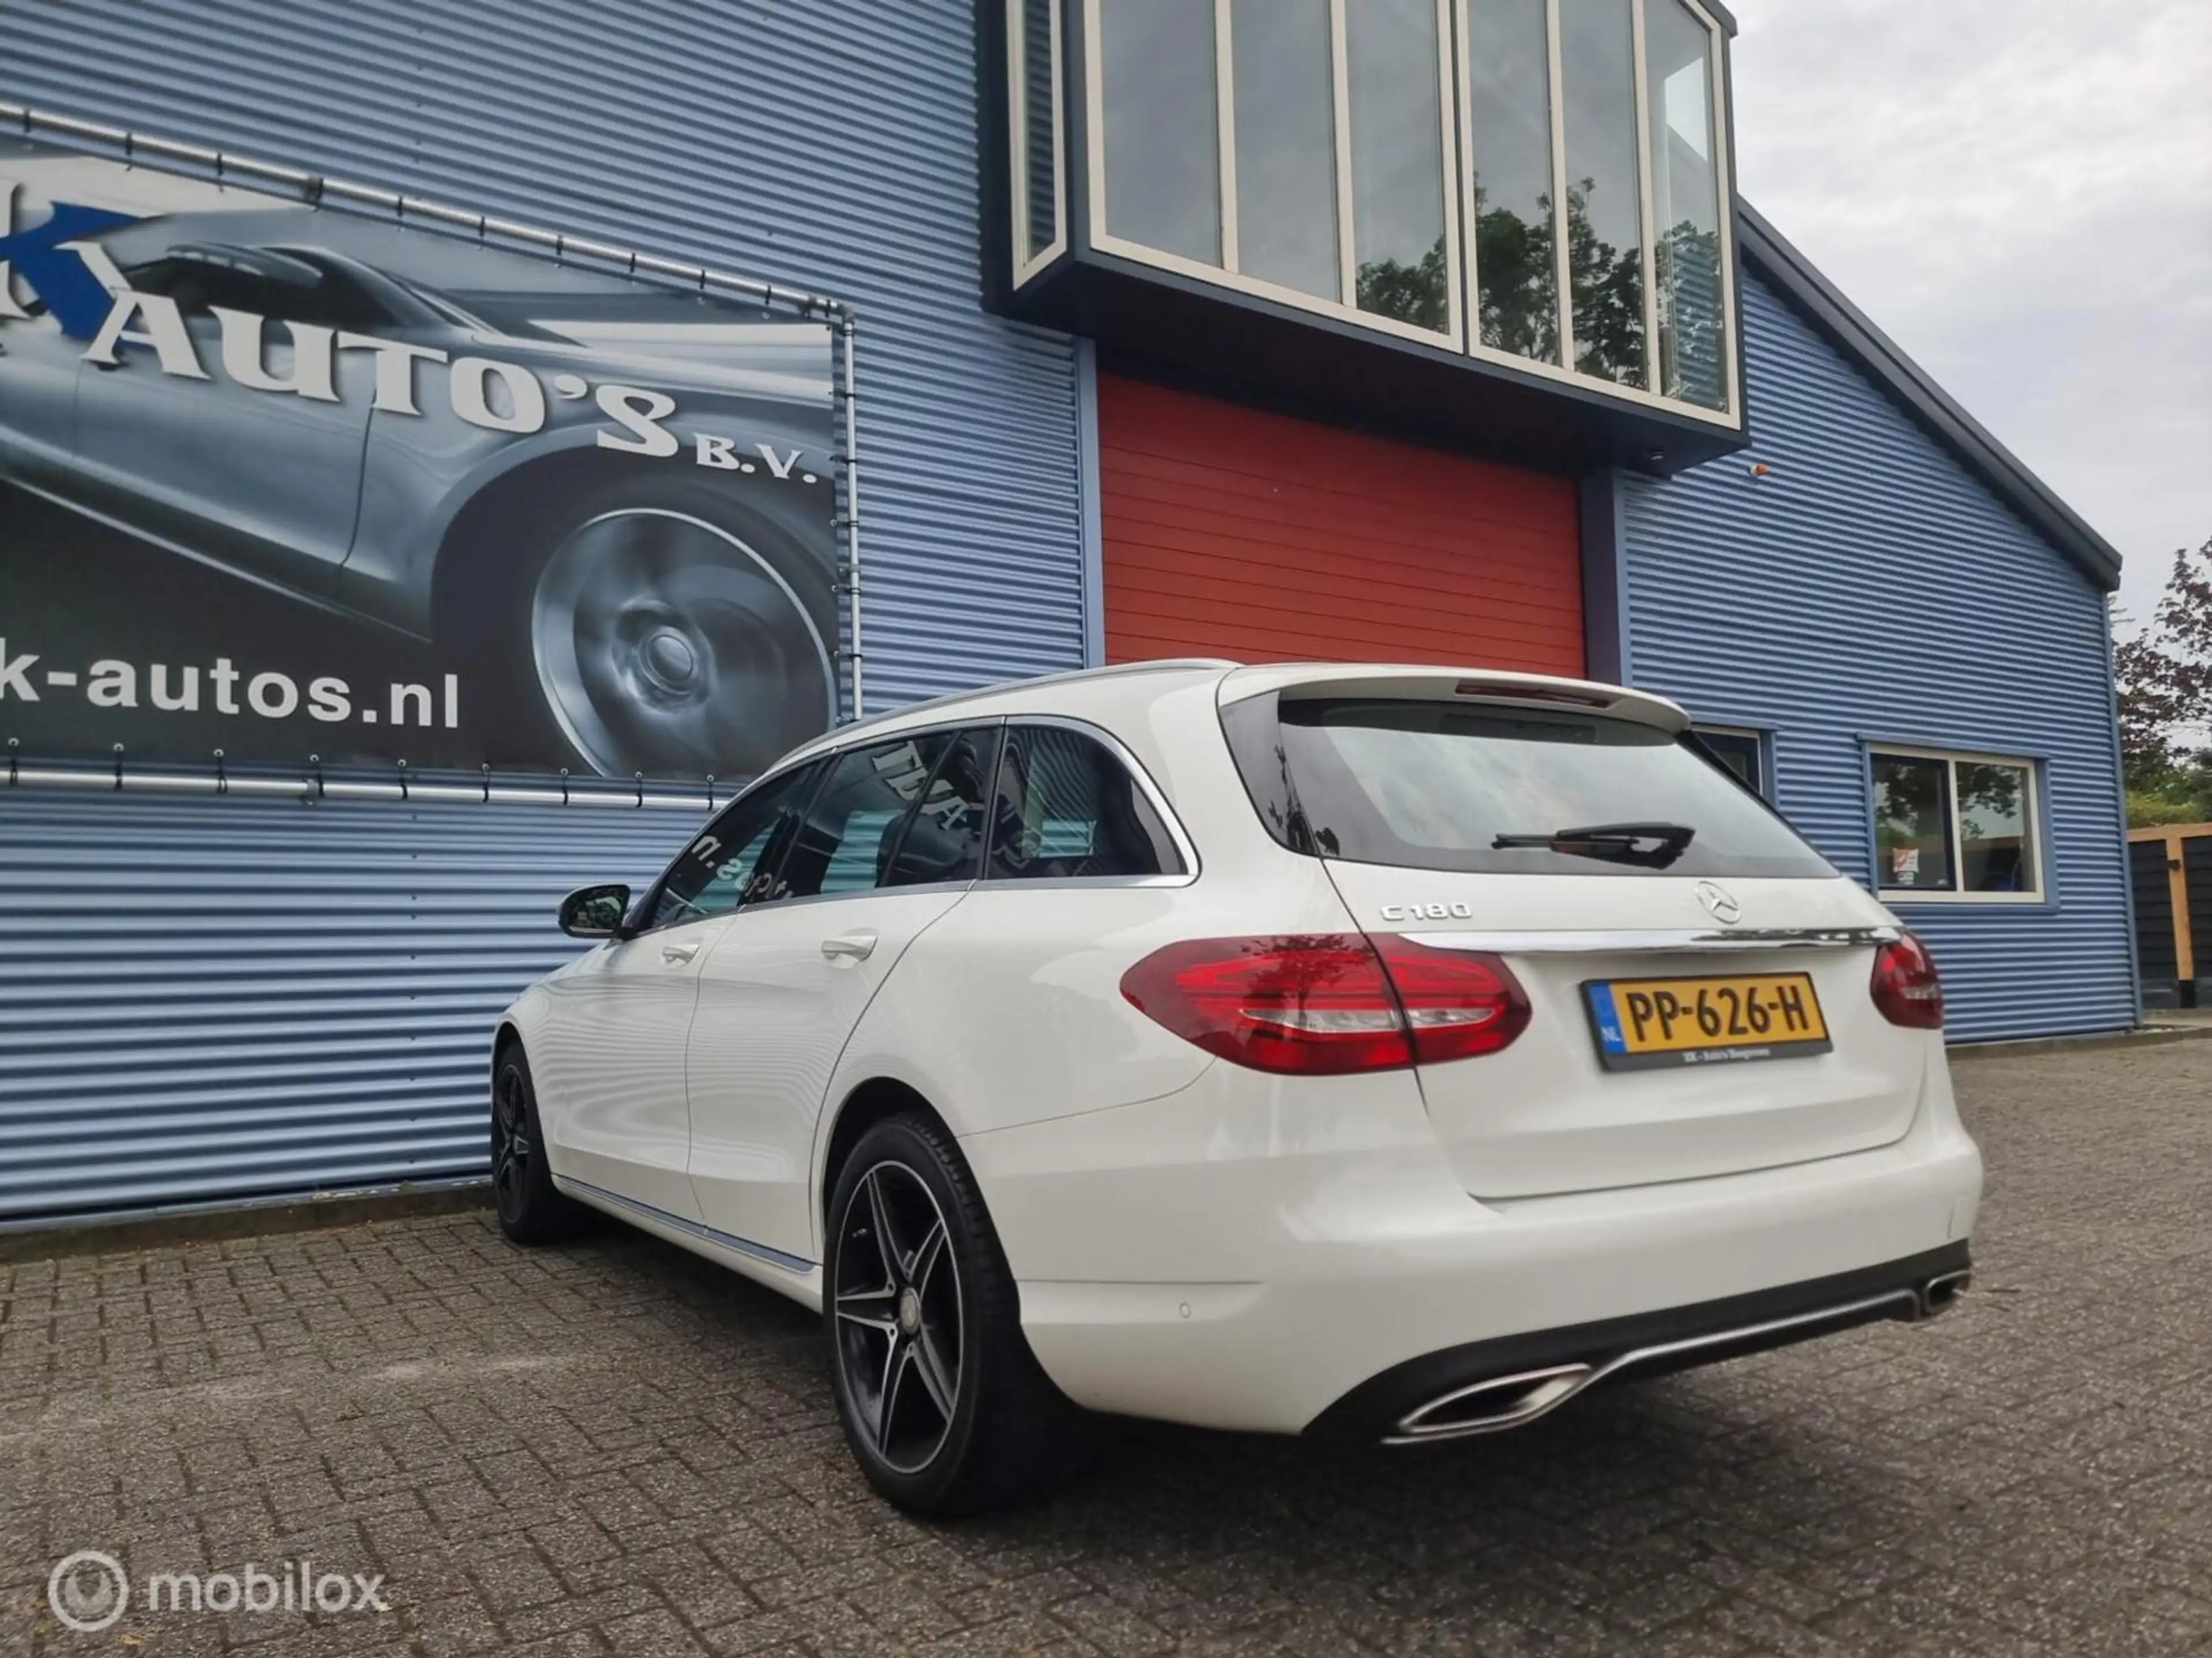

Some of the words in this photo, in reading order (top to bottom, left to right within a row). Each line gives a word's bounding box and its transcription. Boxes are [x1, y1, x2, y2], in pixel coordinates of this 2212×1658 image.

[694, 432, 817, 484] B.V.
[1381, 904, 1404, 921] C
[1411, 902, 1473, 919] 180
[1601, 1027, 1621, 1042] NL
[1626, 985, 1809, 1042] PP-626-H
